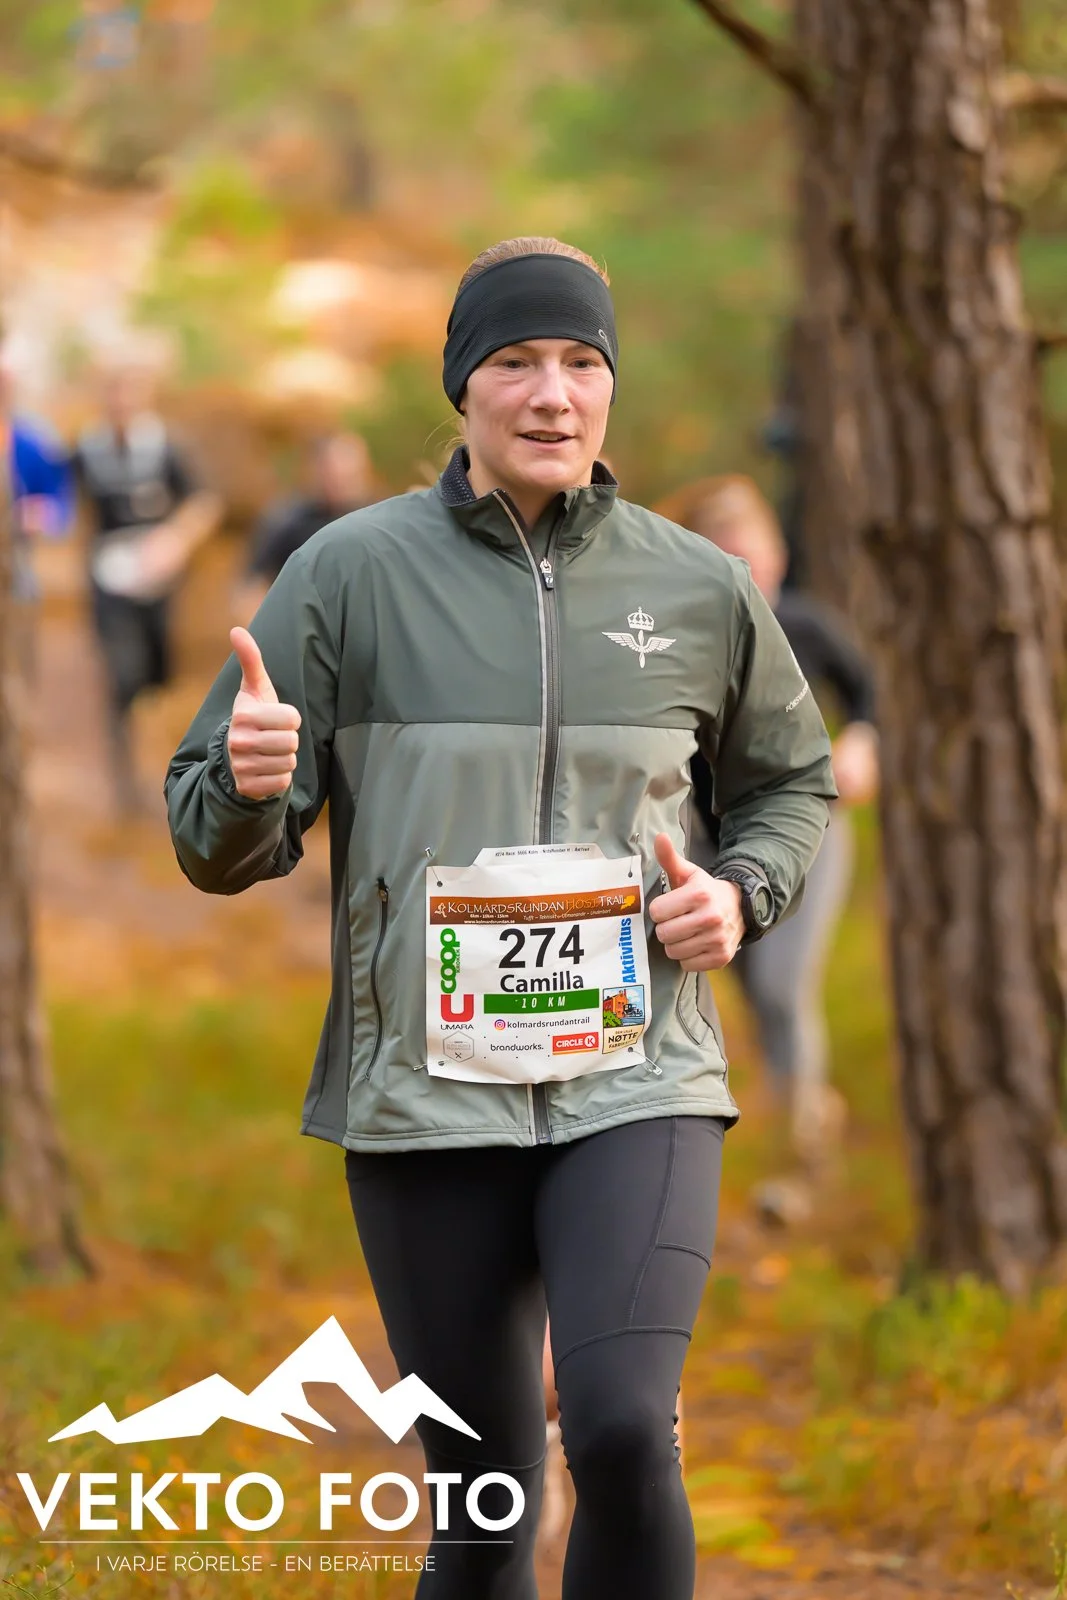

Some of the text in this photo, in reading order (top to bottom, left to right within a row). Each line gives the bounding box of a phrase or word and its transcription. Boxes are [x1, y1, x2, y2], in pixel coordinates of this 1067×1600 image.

[499, 924, 585, 969] 274
[619, 917, 637, 983] Aktivitus
[440, 928, 460, 994] coop
[500, 971, 584, 993] Camilla
[521, 995, 566, 1009] 10 KM
[507, 1017, 590, 1028] kolmardsrundantrail
[555, 1038, 584, 1048] CIRCLE
